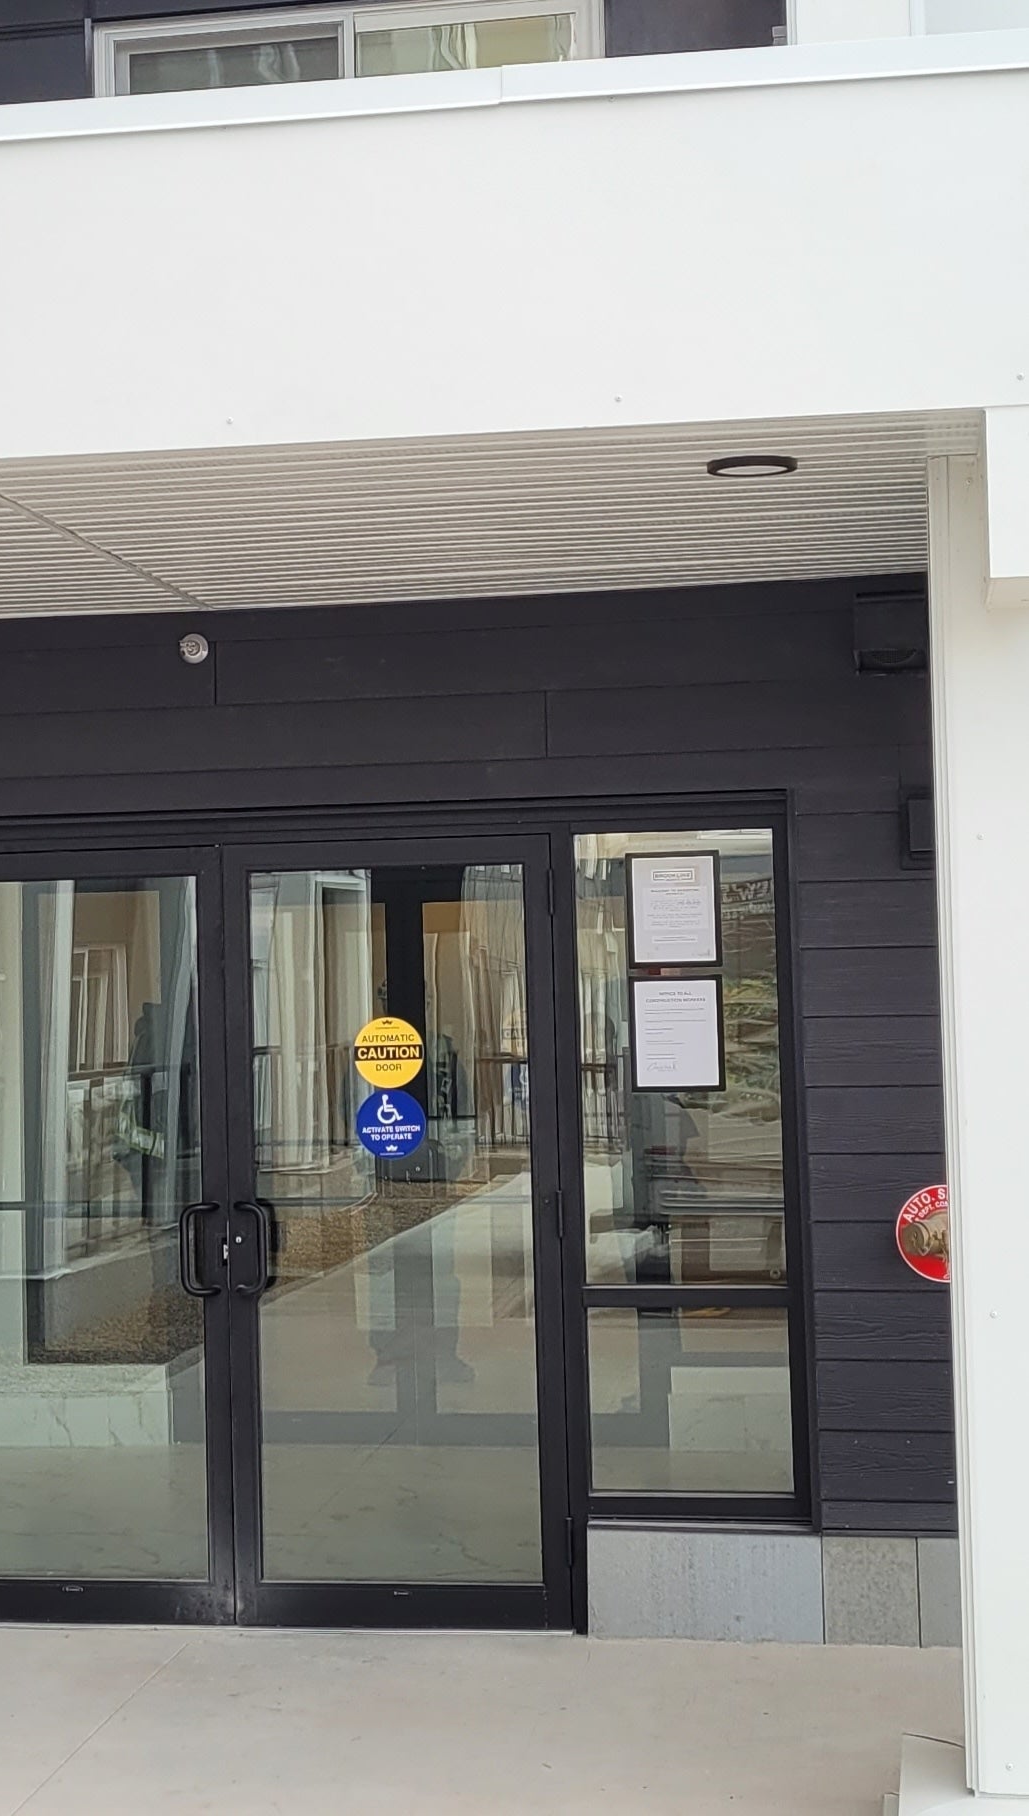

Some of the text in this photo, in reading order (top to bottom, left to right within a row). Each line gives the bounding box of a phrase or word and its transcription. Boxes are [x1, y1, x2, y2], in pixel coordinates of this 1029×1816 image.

[361, 1034, 415, 1043] AUTOMATIC
[357, 1046, 420, 1060] CAUTION
[375, 1063, 402, 1072] DOOR
[362, 1125, 421, 1134] ACTIVATE SWITCH
[381, 1133, 413, 1141] OPERATE
[902, 1188, 948, 1223] AUTO. S
